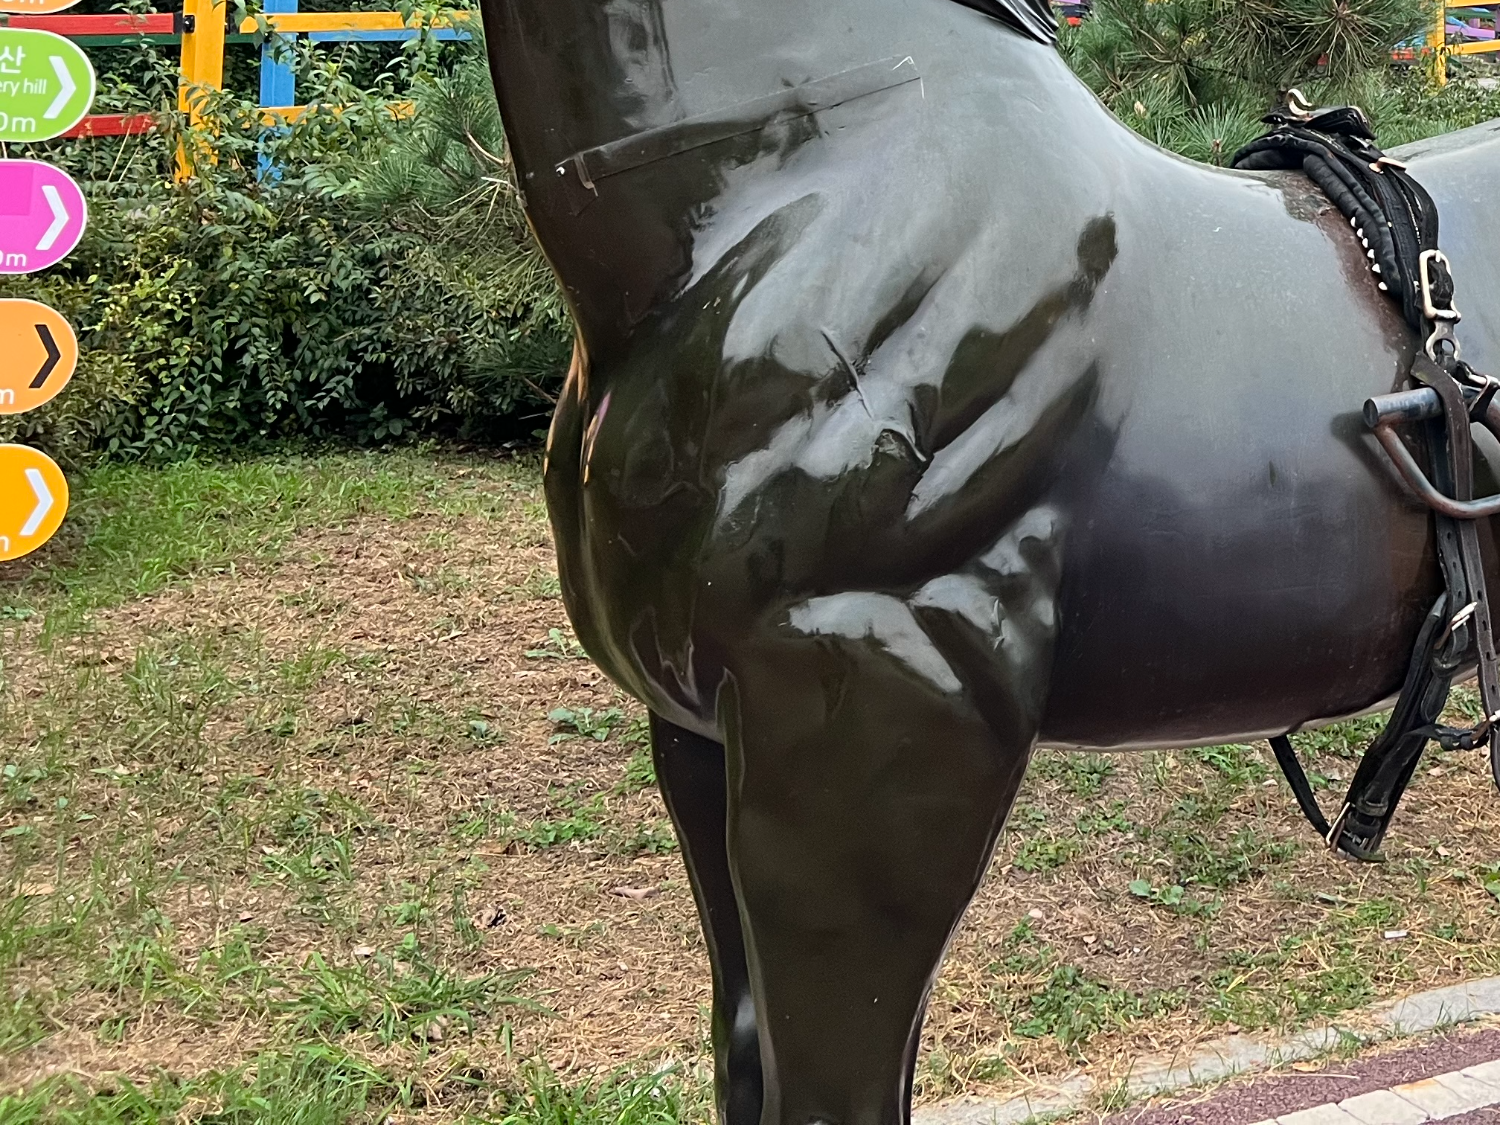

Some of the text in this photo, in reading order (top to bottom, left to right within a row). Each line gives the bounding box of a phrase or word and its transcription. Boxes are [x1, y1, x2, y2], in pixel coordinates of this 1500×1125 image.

[0, 45, 26, 73] 산
[0, 78, 47, 97] ry hill
[0, 249, 27, 267] m
